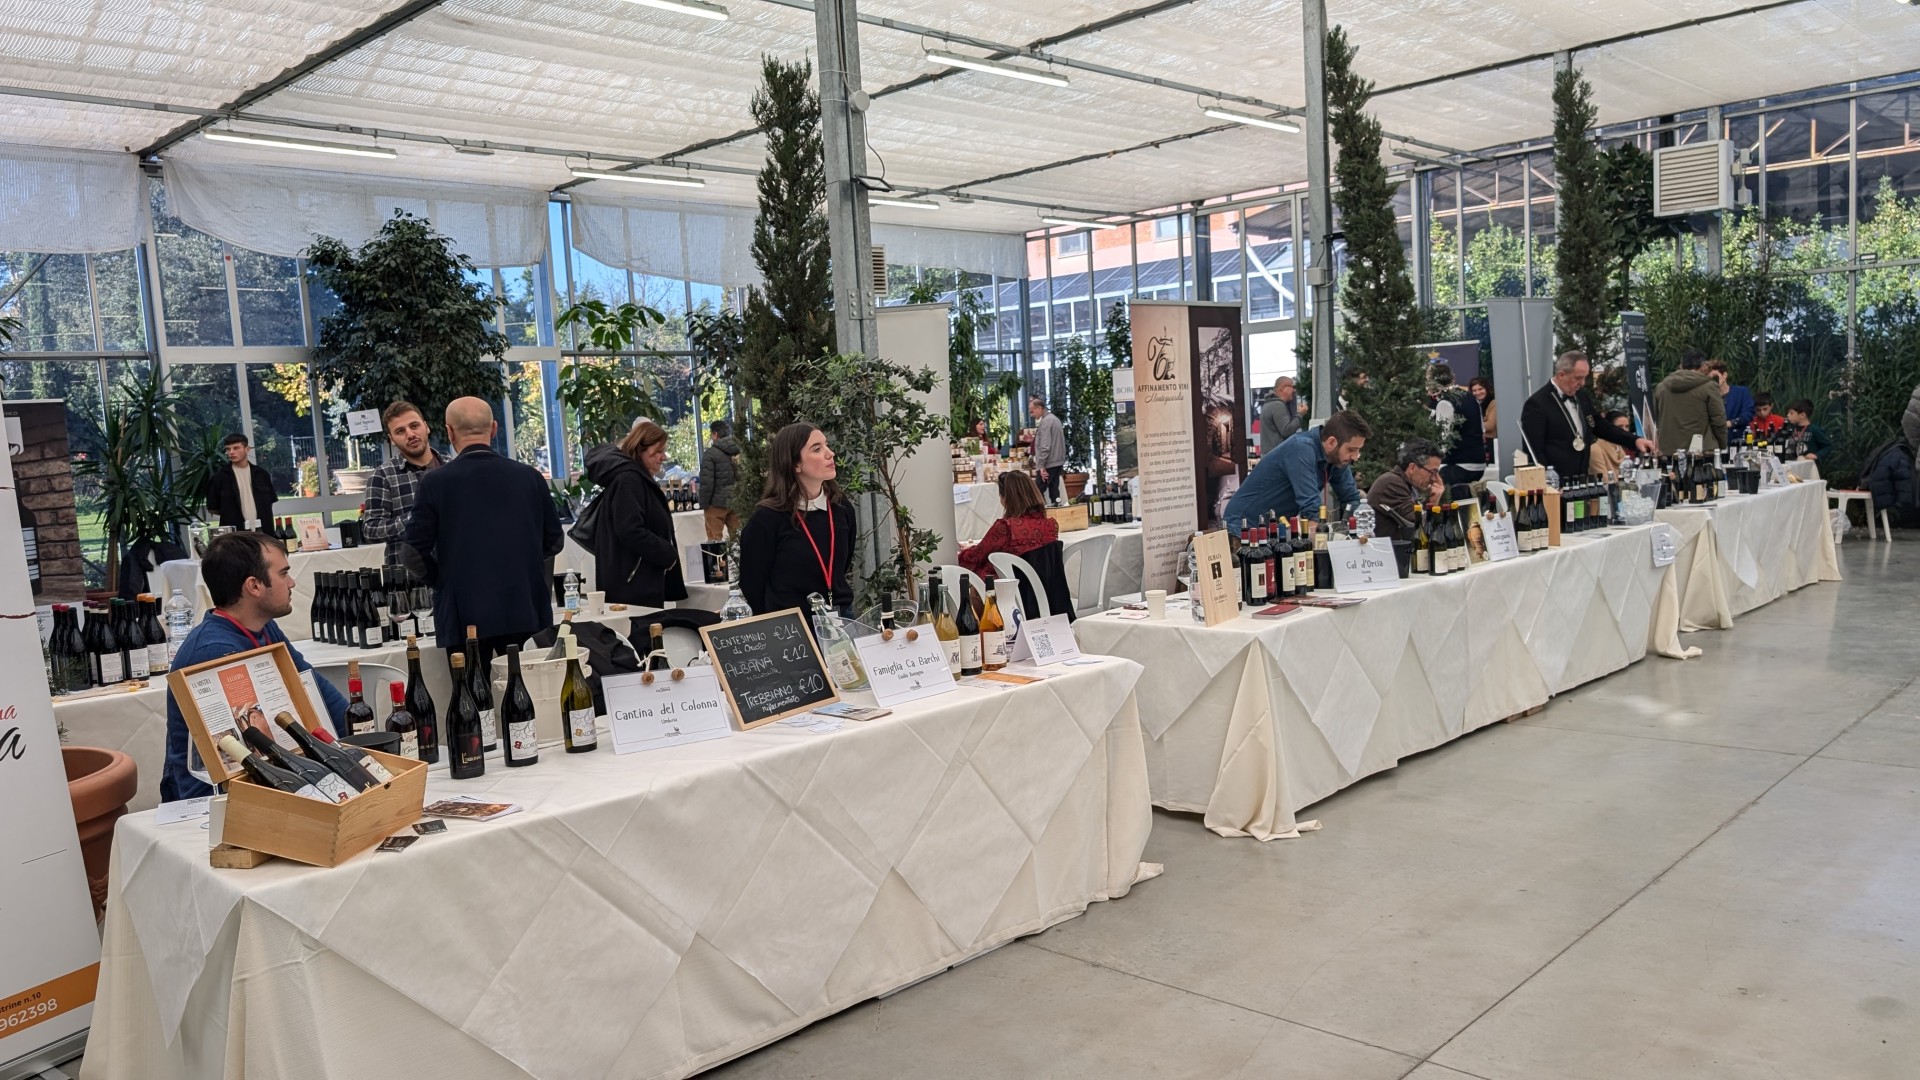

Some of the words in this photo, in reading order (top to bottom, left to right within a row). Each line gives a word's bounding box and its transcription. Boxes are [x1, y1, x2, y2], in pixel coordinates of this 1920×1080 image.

[1137, 383, 1177, 392] AFFINAMENTO
[1346, 560, 1357, 569] Col
[1361, 558, 1384, 568] d'Orcia
[712, 632, 766, 650] CENTESIMINO
[773, 623, 802, 640] €14
[725, 656, 774, 678] ALBANA
[782, 643, 809, 662] €12
[733, 645, 742, 655] di
[873, 661, 903, 676] Famiglia
[918, 652, 941, 666] Barchi
[740, 684, 793, 709] TREBBIANO
[799, 673, 825, 694] €10
[0, 704, 17, 720] a
[615, 708, 653, 721] Cantina
[660, 702, 675, 715] del
[681, 698, 718, 712] Colonna
[0, 1001, 22, 1013] trine
[24, 992, 42, 1004] n.10
[0, 998, 58, 1032] 962398
